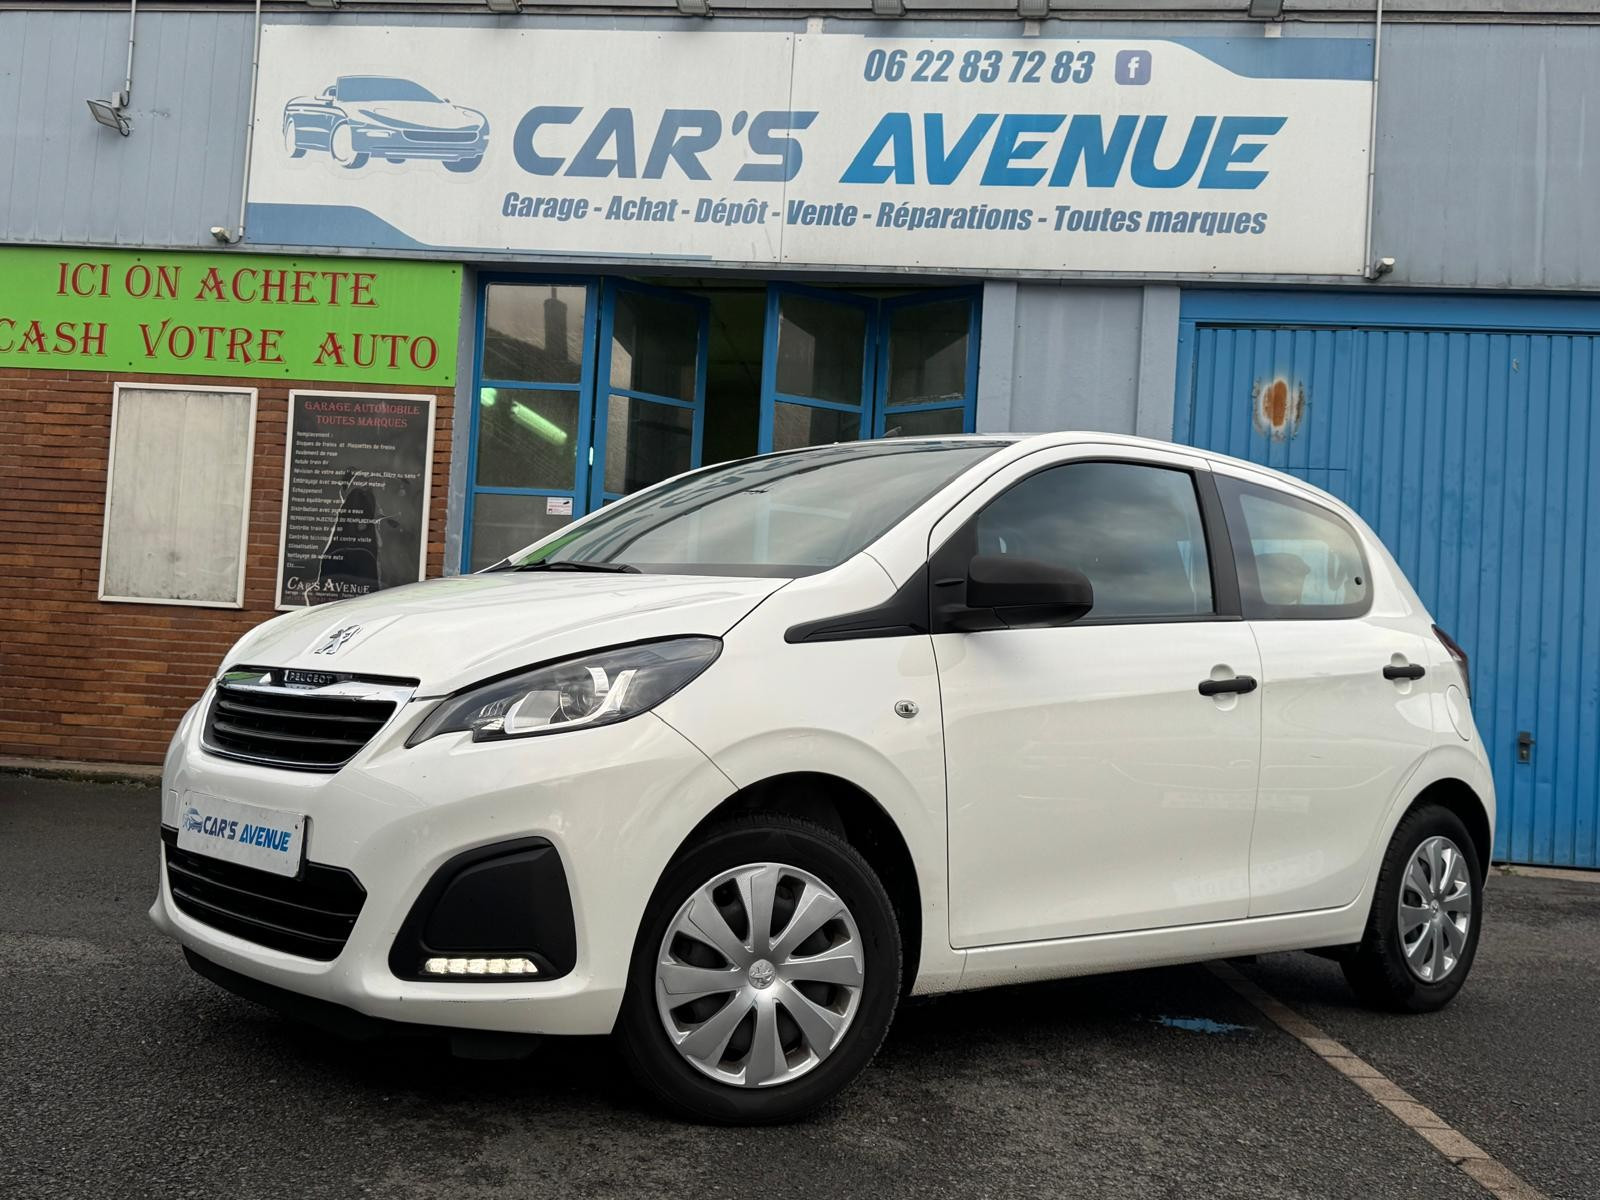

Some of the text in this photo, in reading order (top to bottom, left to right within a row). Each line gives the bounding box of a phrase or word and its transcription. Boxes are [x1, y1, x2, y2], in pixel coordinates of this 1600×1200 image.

[864, 48, 1096, 84] 06 22 83 72 83
[513, 105, 1288, 190] CAR'S AVENUE
[502, 191, 589, 222] Garage
[605, 195, 680, 222] Achat
[695, 197, 769, 226] Dépôt
[786, 199, 857, 227] Vente
[876, 202, 1032, 231] Réparations
[1054, 205, 1142, 233] Toutes
[1146, 208, 1268, 236] marques
[56, 262, 378, 308] ICI ON ACHETE
[139, 318, 285, 364] VOTRE
[313, 331, 439, 370] AUTO
[304, 401, 421, 415] GARAGE AUTOMOBILE
[316, 415, 408, 428] TOUTES MARQUES
[290, 671, 333, 684] PEUGEOT
[203, 815, 293, 852] CAR'S AVENUE
